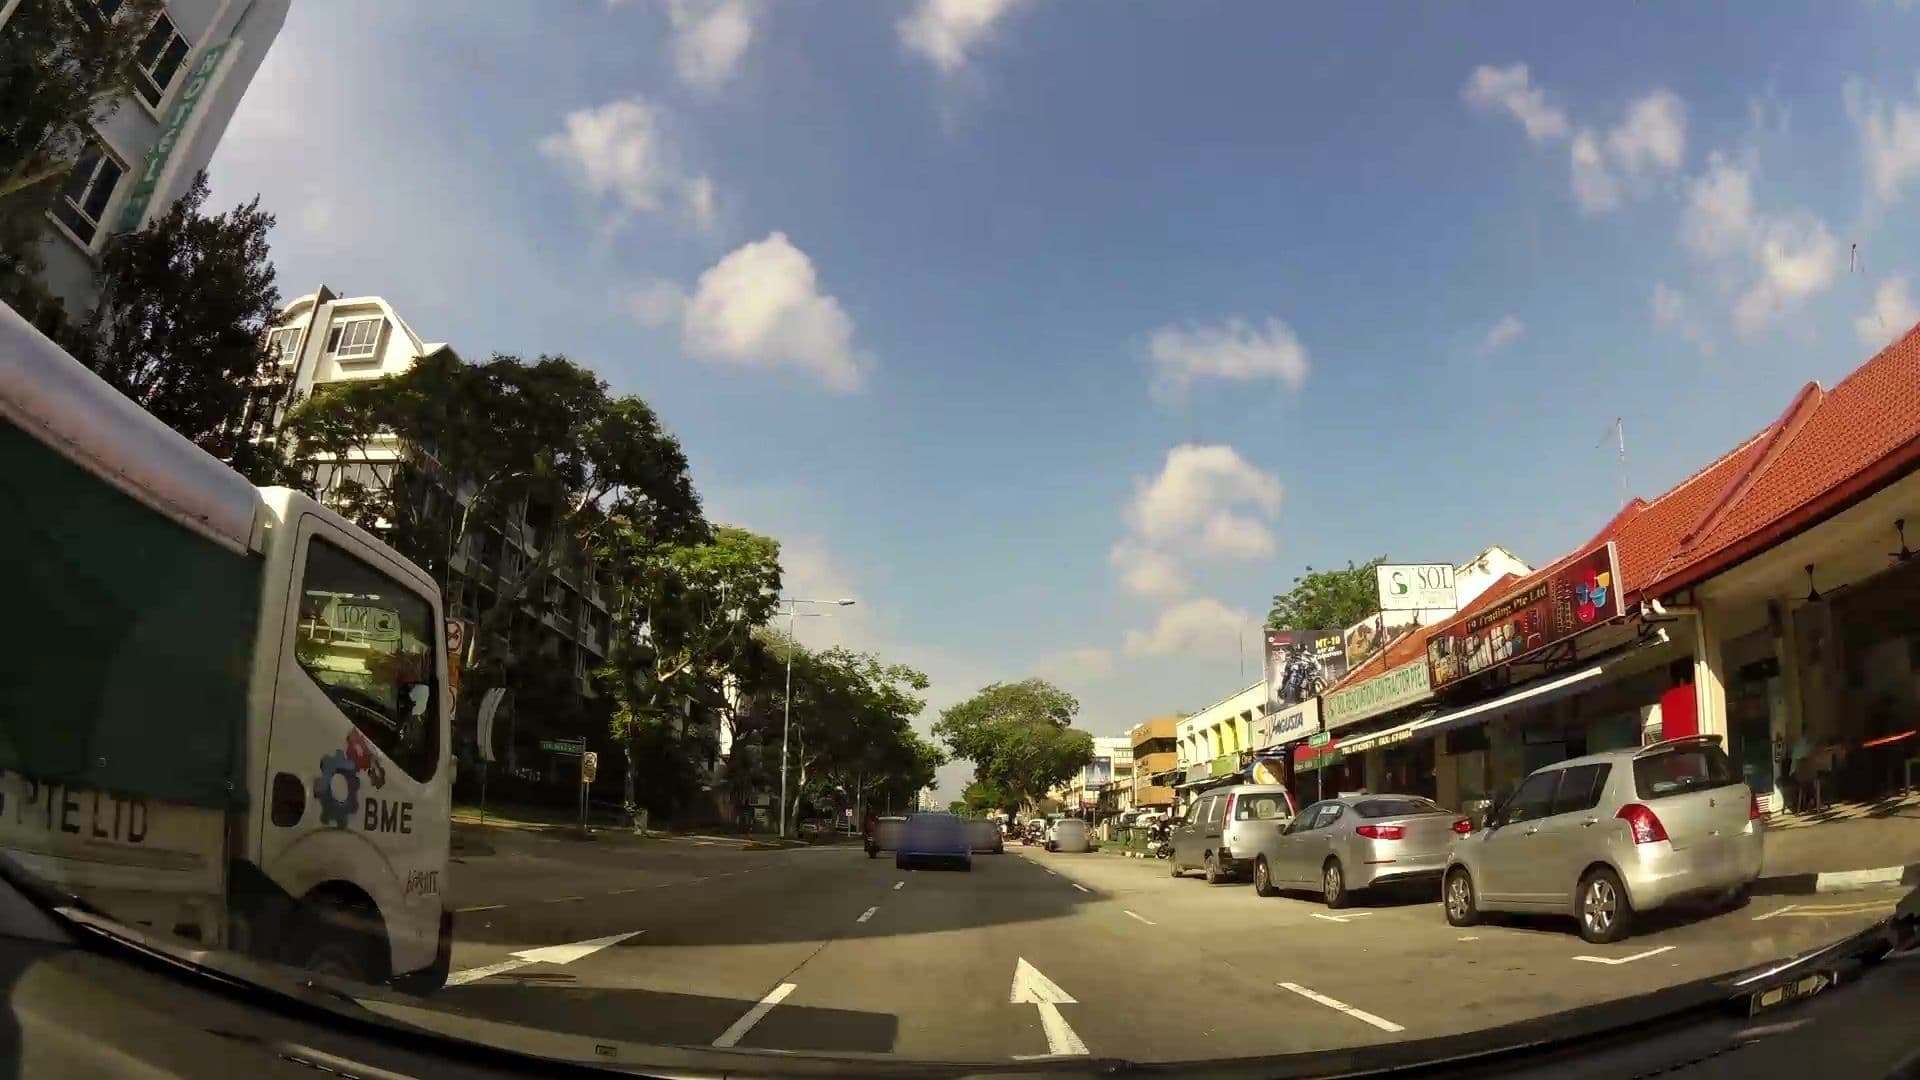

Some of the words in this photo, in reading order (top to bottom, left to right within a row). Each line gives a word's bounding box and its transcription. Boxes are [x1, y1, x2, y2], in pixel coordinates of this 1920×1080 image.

[1418, 566, 1453, 590] SOL
[1513, 596, 1528, 609] Pte
[1530, 584, 1547, 601] Ltd
[1346, 682, 1375, 712] RENOVATION
[1375, 668, 1410, 702] CONTRACTOR
[93, 792, 147, 842] LTD
[364, 797, 413, 833] BME
